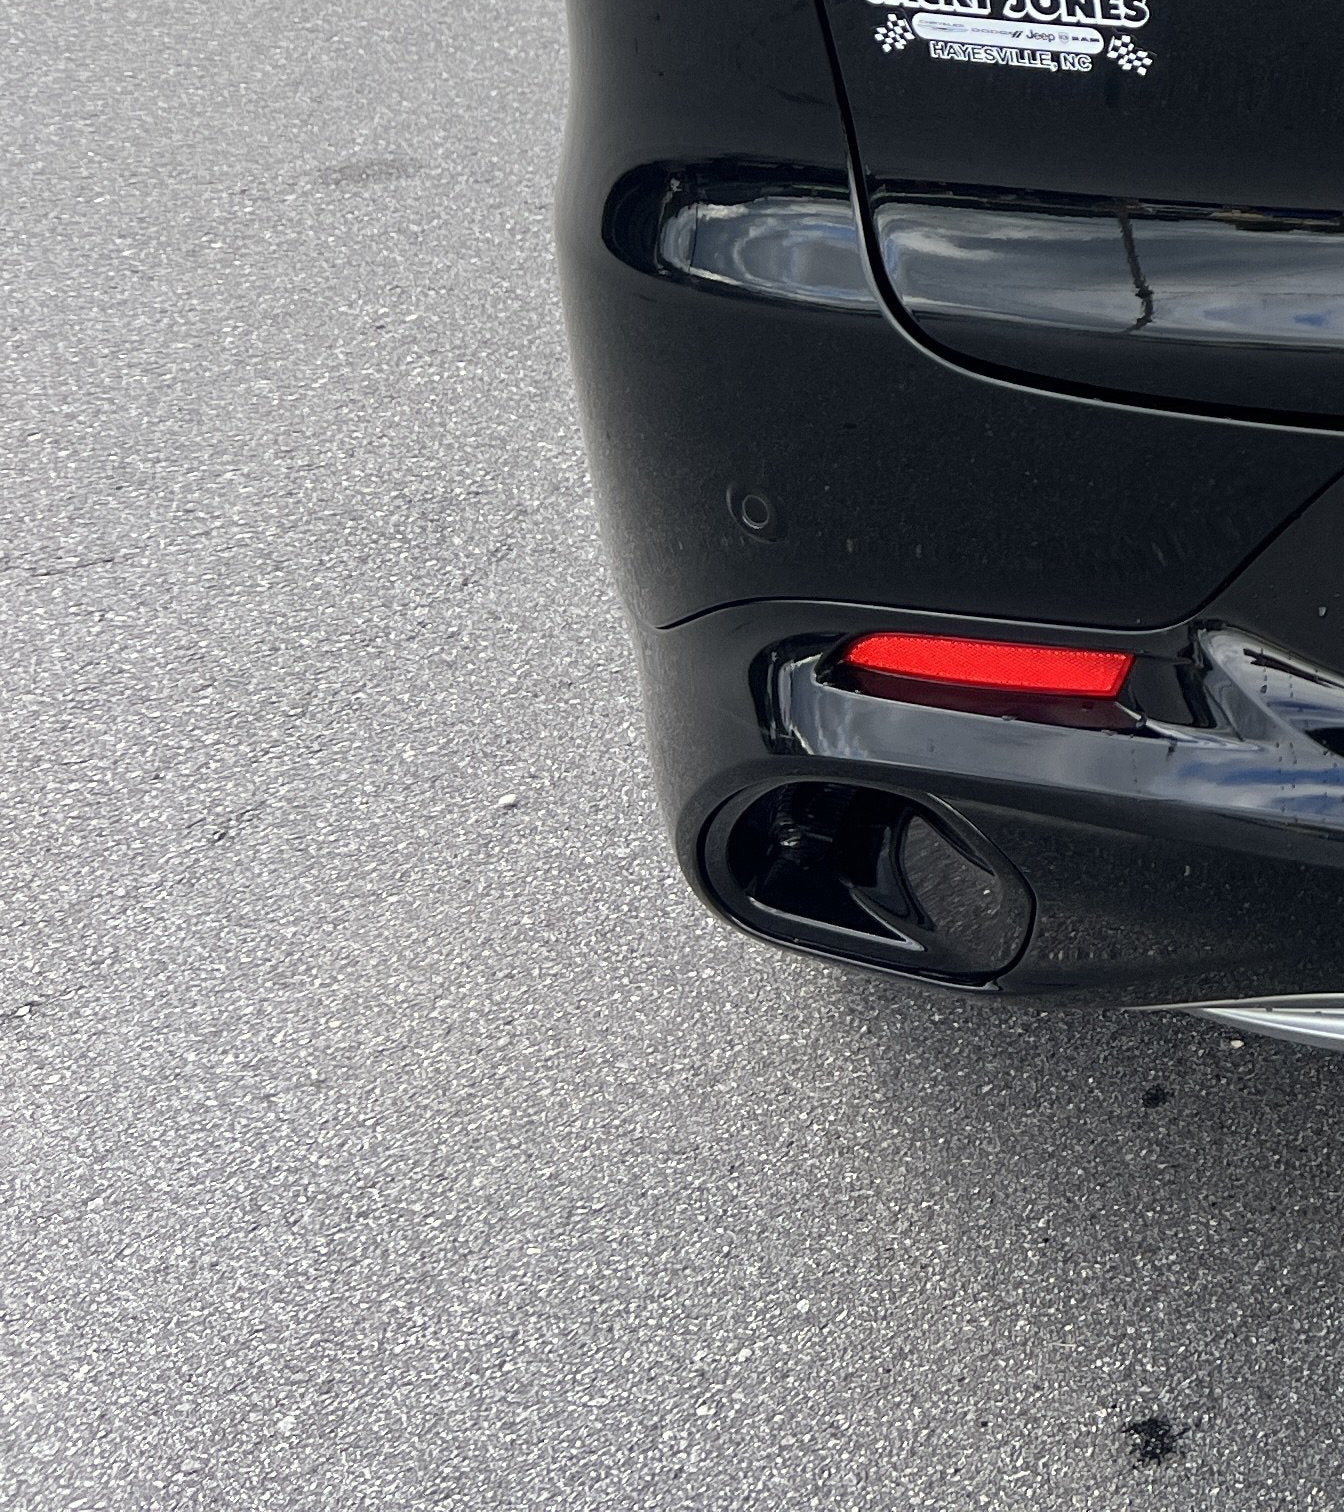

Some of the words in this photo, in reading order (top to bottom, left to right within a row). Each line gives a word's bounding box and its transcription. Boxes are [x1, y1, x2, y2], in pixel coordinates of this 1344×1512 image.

[1026, 29, 1055, 42] Jeep
[929, 40, 1058, 72] HAYESVILLE,
[1060, 53, 1093, 72] NC
